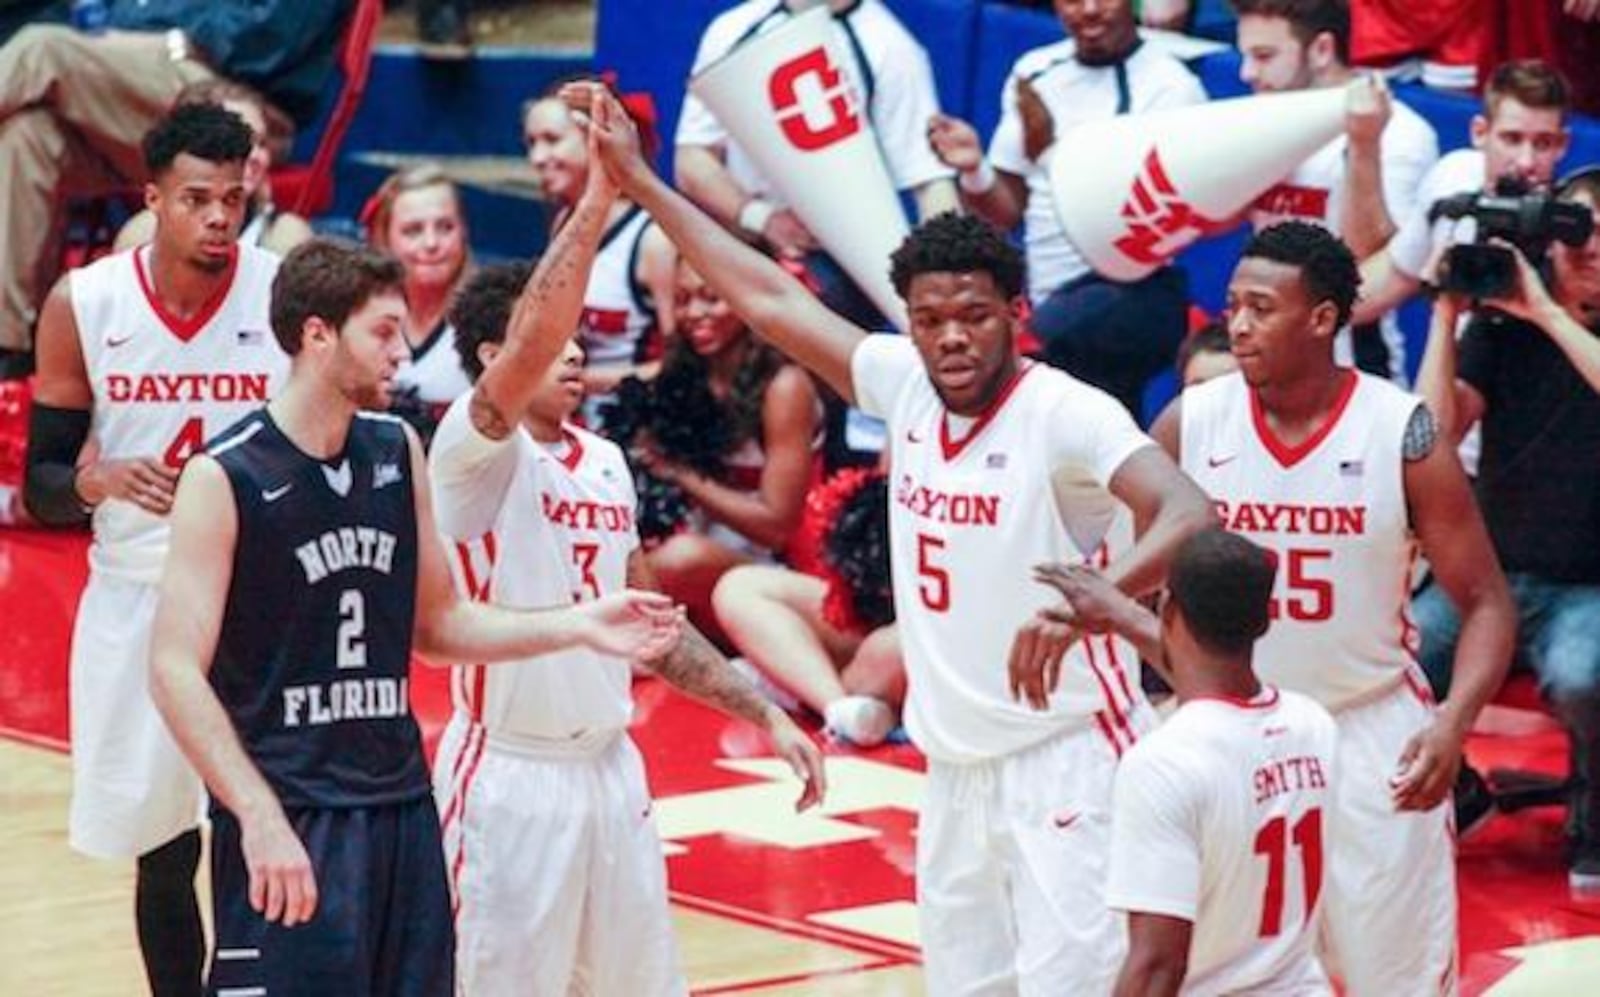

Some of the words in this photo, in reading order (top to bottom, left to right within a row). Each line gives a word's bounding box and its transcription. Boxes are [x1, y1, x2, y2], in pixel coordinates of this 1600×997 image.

[106, 374, 268, 402] DAYTON
[164, 417, 204, 468] 4
[295, 526, 397, 584] NORTH
[572, 543, 601, 603] 3
[918, 533, 951, 612] 5
[1262, 549, 1334, 621] 5
[336, 588, 367, 669] 2
[1254, 756, 1326, 803] SMITH
[1254, 807, 1323, 938] 11
